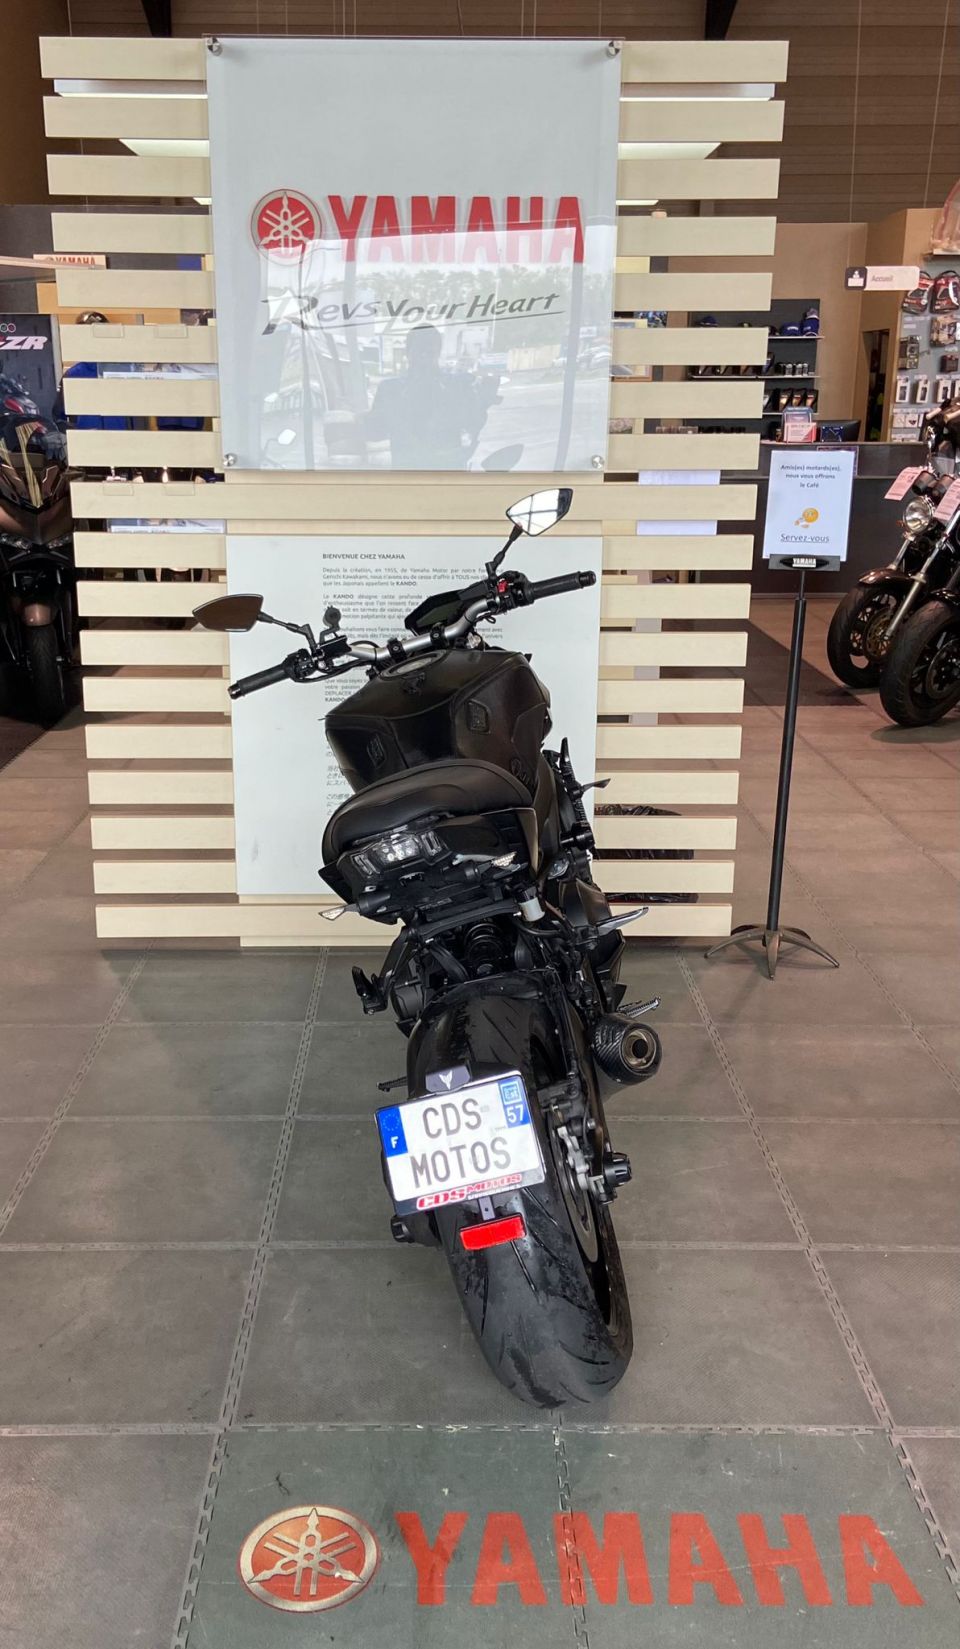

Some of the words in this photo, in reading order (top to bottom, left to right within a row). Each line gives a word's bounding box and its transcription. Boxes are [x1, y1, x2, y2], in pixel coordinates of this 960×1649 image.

[327, 195, 584, 264] YAMAHA
[55, 256, 96, 265] YAMAHA
[871, 274, 894, 282] Accueil
[261, 289, 378, 335] Revs
[383, 299, 466, 329] Your
[466, 293, 561, 319] Heart
[0, 336, 48, 350] ZR
[781, 464, 805, 472] Amis(es)
[780, 533, 830, 543] Servez-vous
[792, 557, 817, 566] YAMAHA
[421, 1097, 483, 1140] CDS
[506, 1104, 524, 1123] 57
[390, 1136, 399, 1149] F
[409, 1136, 512, 1190] MOTOS
[417, 1187, 467, 1210] CDS
[395, 1511, 925, 1606] YAMAHA
